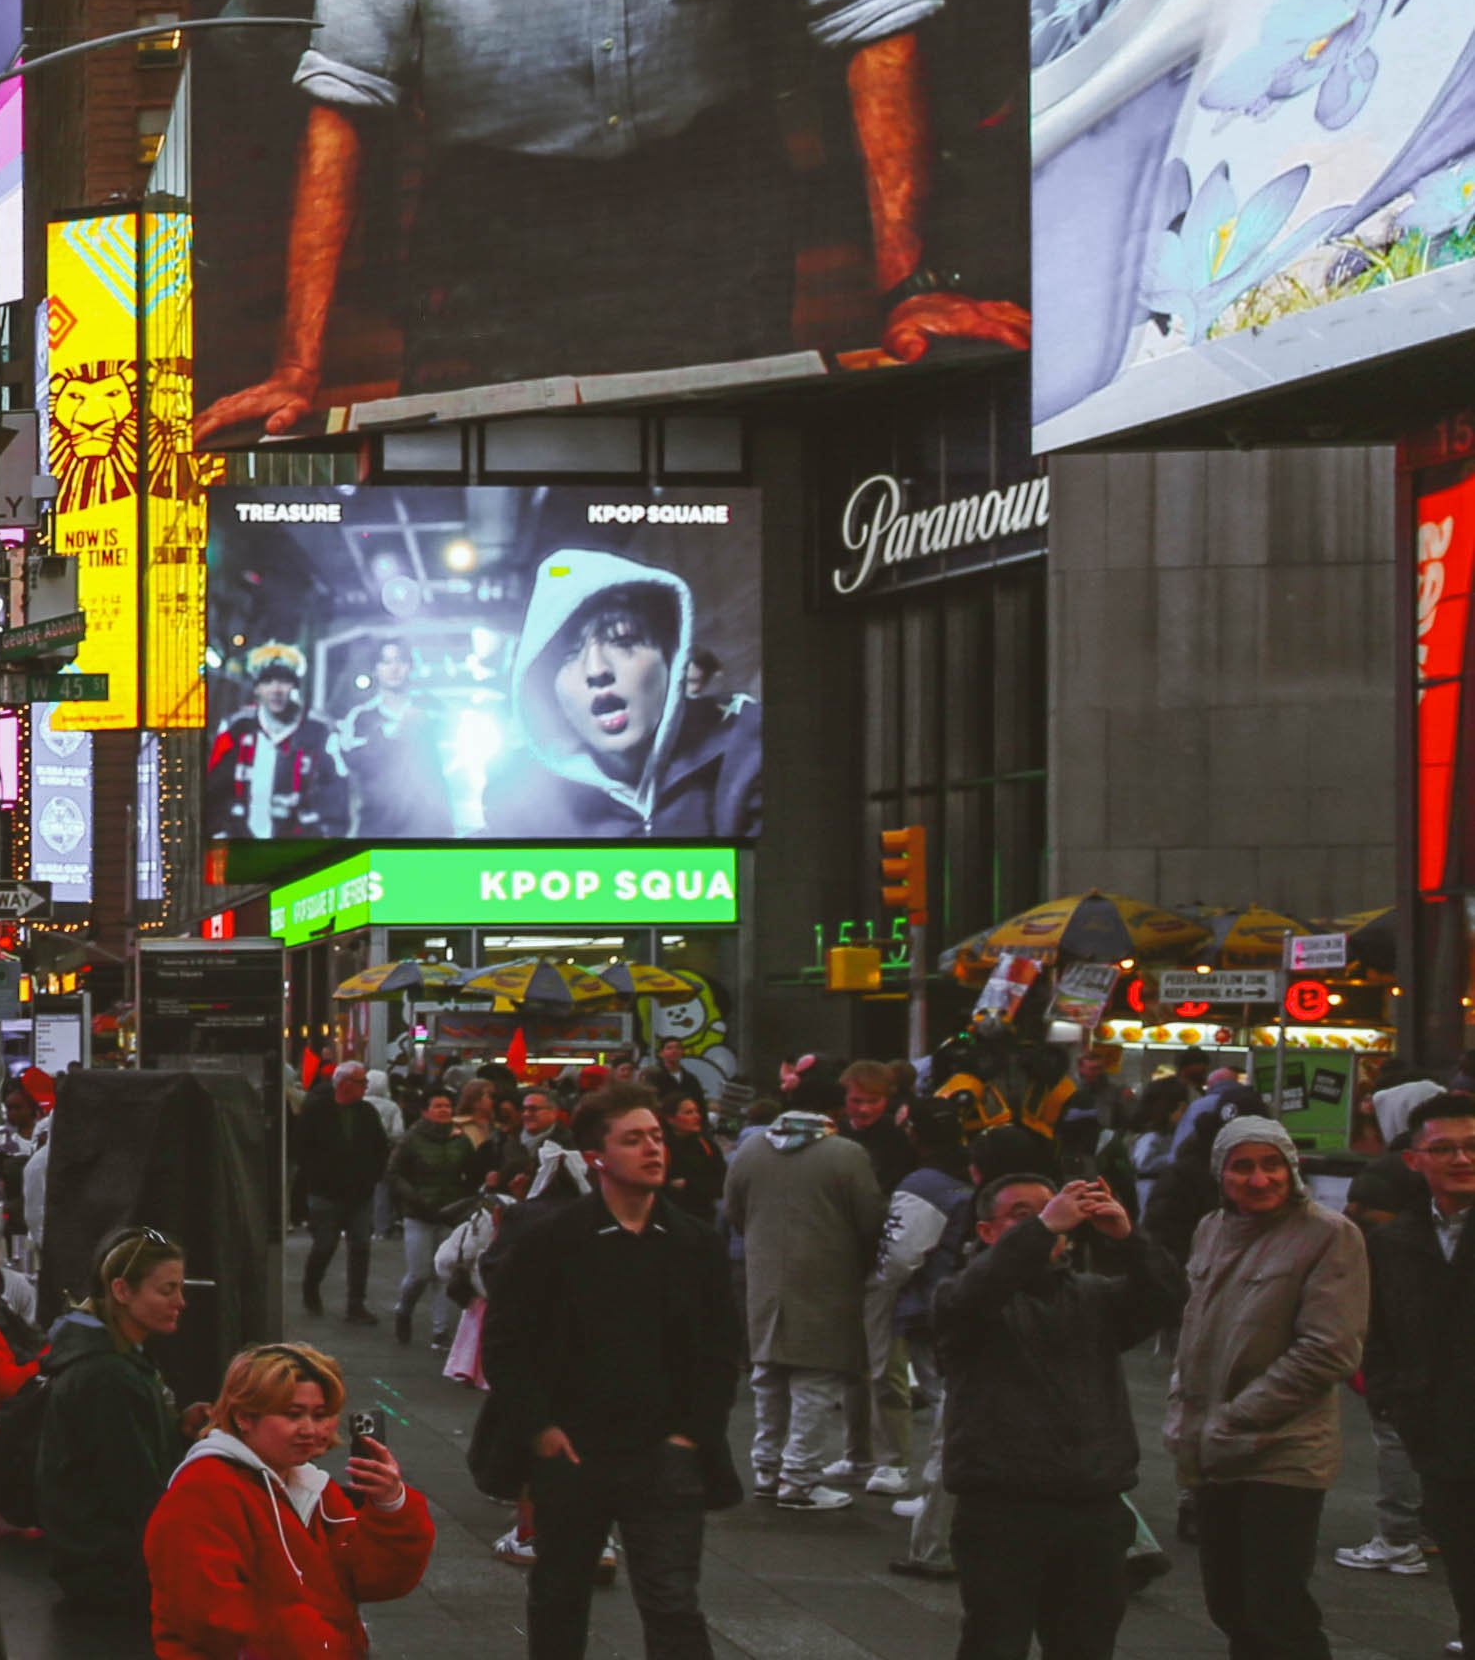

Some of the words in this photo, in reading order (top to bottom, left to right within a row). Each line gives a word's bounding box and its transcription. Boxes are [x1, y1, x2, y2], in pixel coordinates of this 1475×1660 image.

[236, 503, 342, 523] TREASURE
[588, 504, 646, 524] KPOP
[647, 504, 729, 524] SQUARE
[65, 531, 99, 548] NOW
[104, 528, 119, 546] IS
[833, 474, 1049, 593] Paramoun
[88, 548, 128, 567] TIME!
[30, 678, 49, 699] W
[59, 676, 84, 699] 45
[480, 870, 600, 900] KPOP
[614, 870, 734, 900] SQUA
